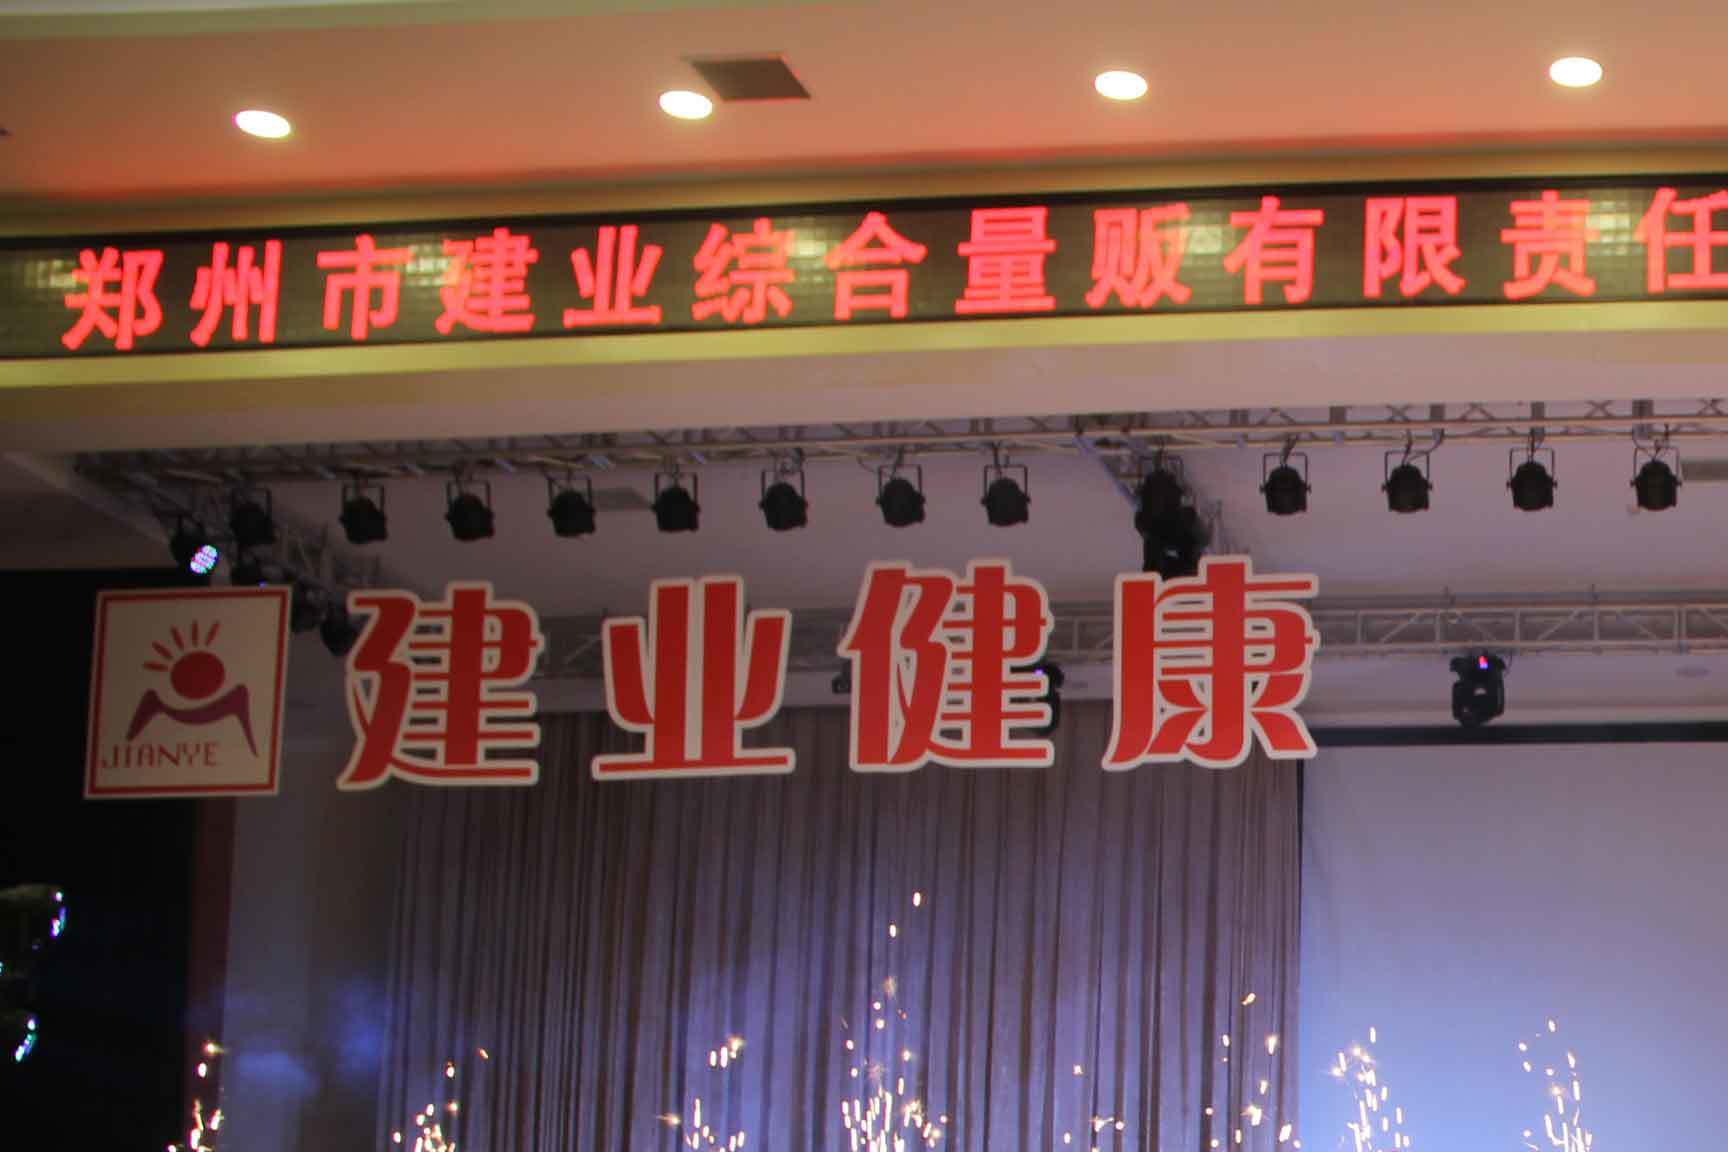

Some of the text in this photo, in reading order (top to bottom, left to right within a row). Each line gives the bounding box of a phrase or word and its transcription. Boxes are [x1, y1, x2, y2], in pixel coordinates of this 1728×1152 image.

[337, 555, 1320, 790] 建业健康
[101, 741, 218, 768] JIANYE
